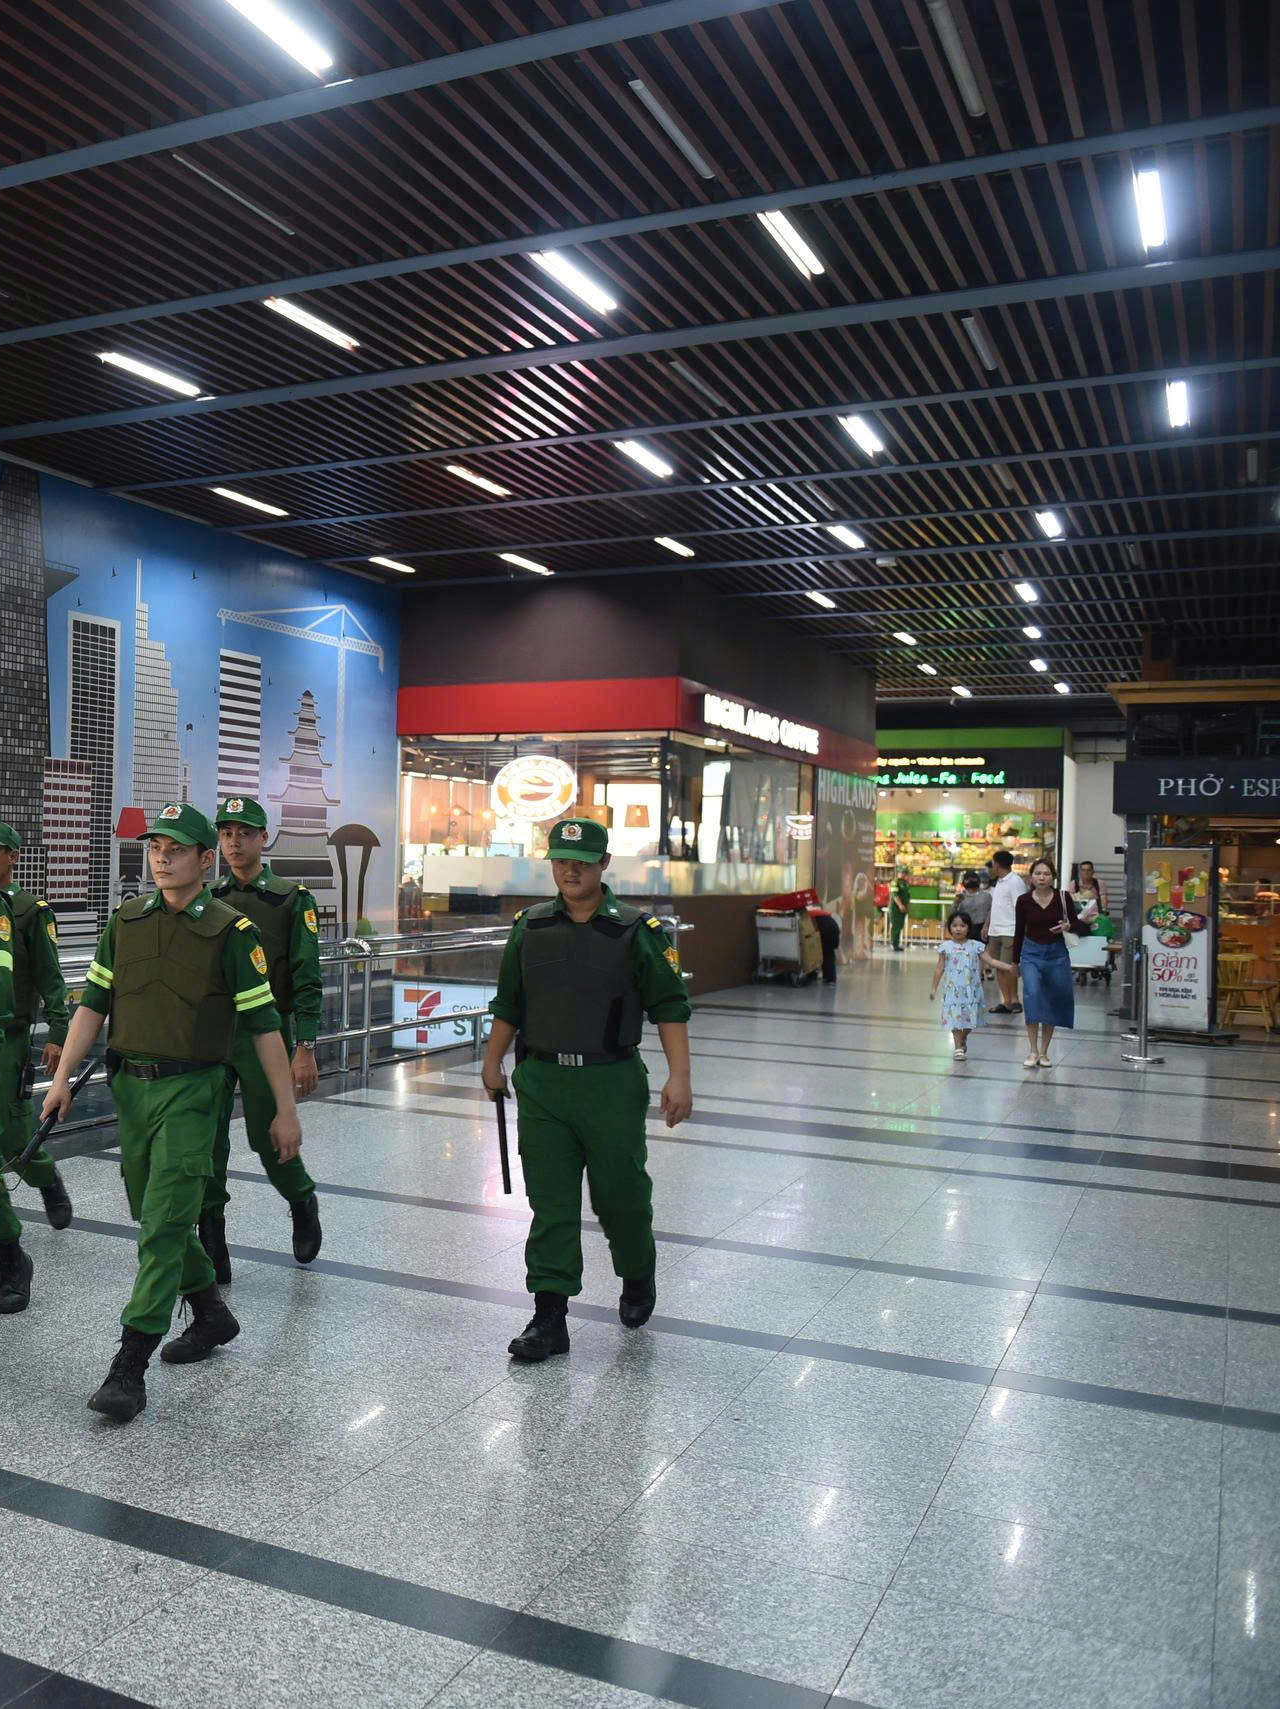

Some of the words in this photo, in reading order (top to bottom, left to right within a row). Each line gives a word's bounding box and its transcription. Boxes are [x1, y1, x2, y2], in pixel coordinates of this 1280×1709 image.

[1158, 773, 1224, 796] PHỞ
[1152, 950, 1198, 969] Giảm
[1151, 968, 1183, 982] 50%
